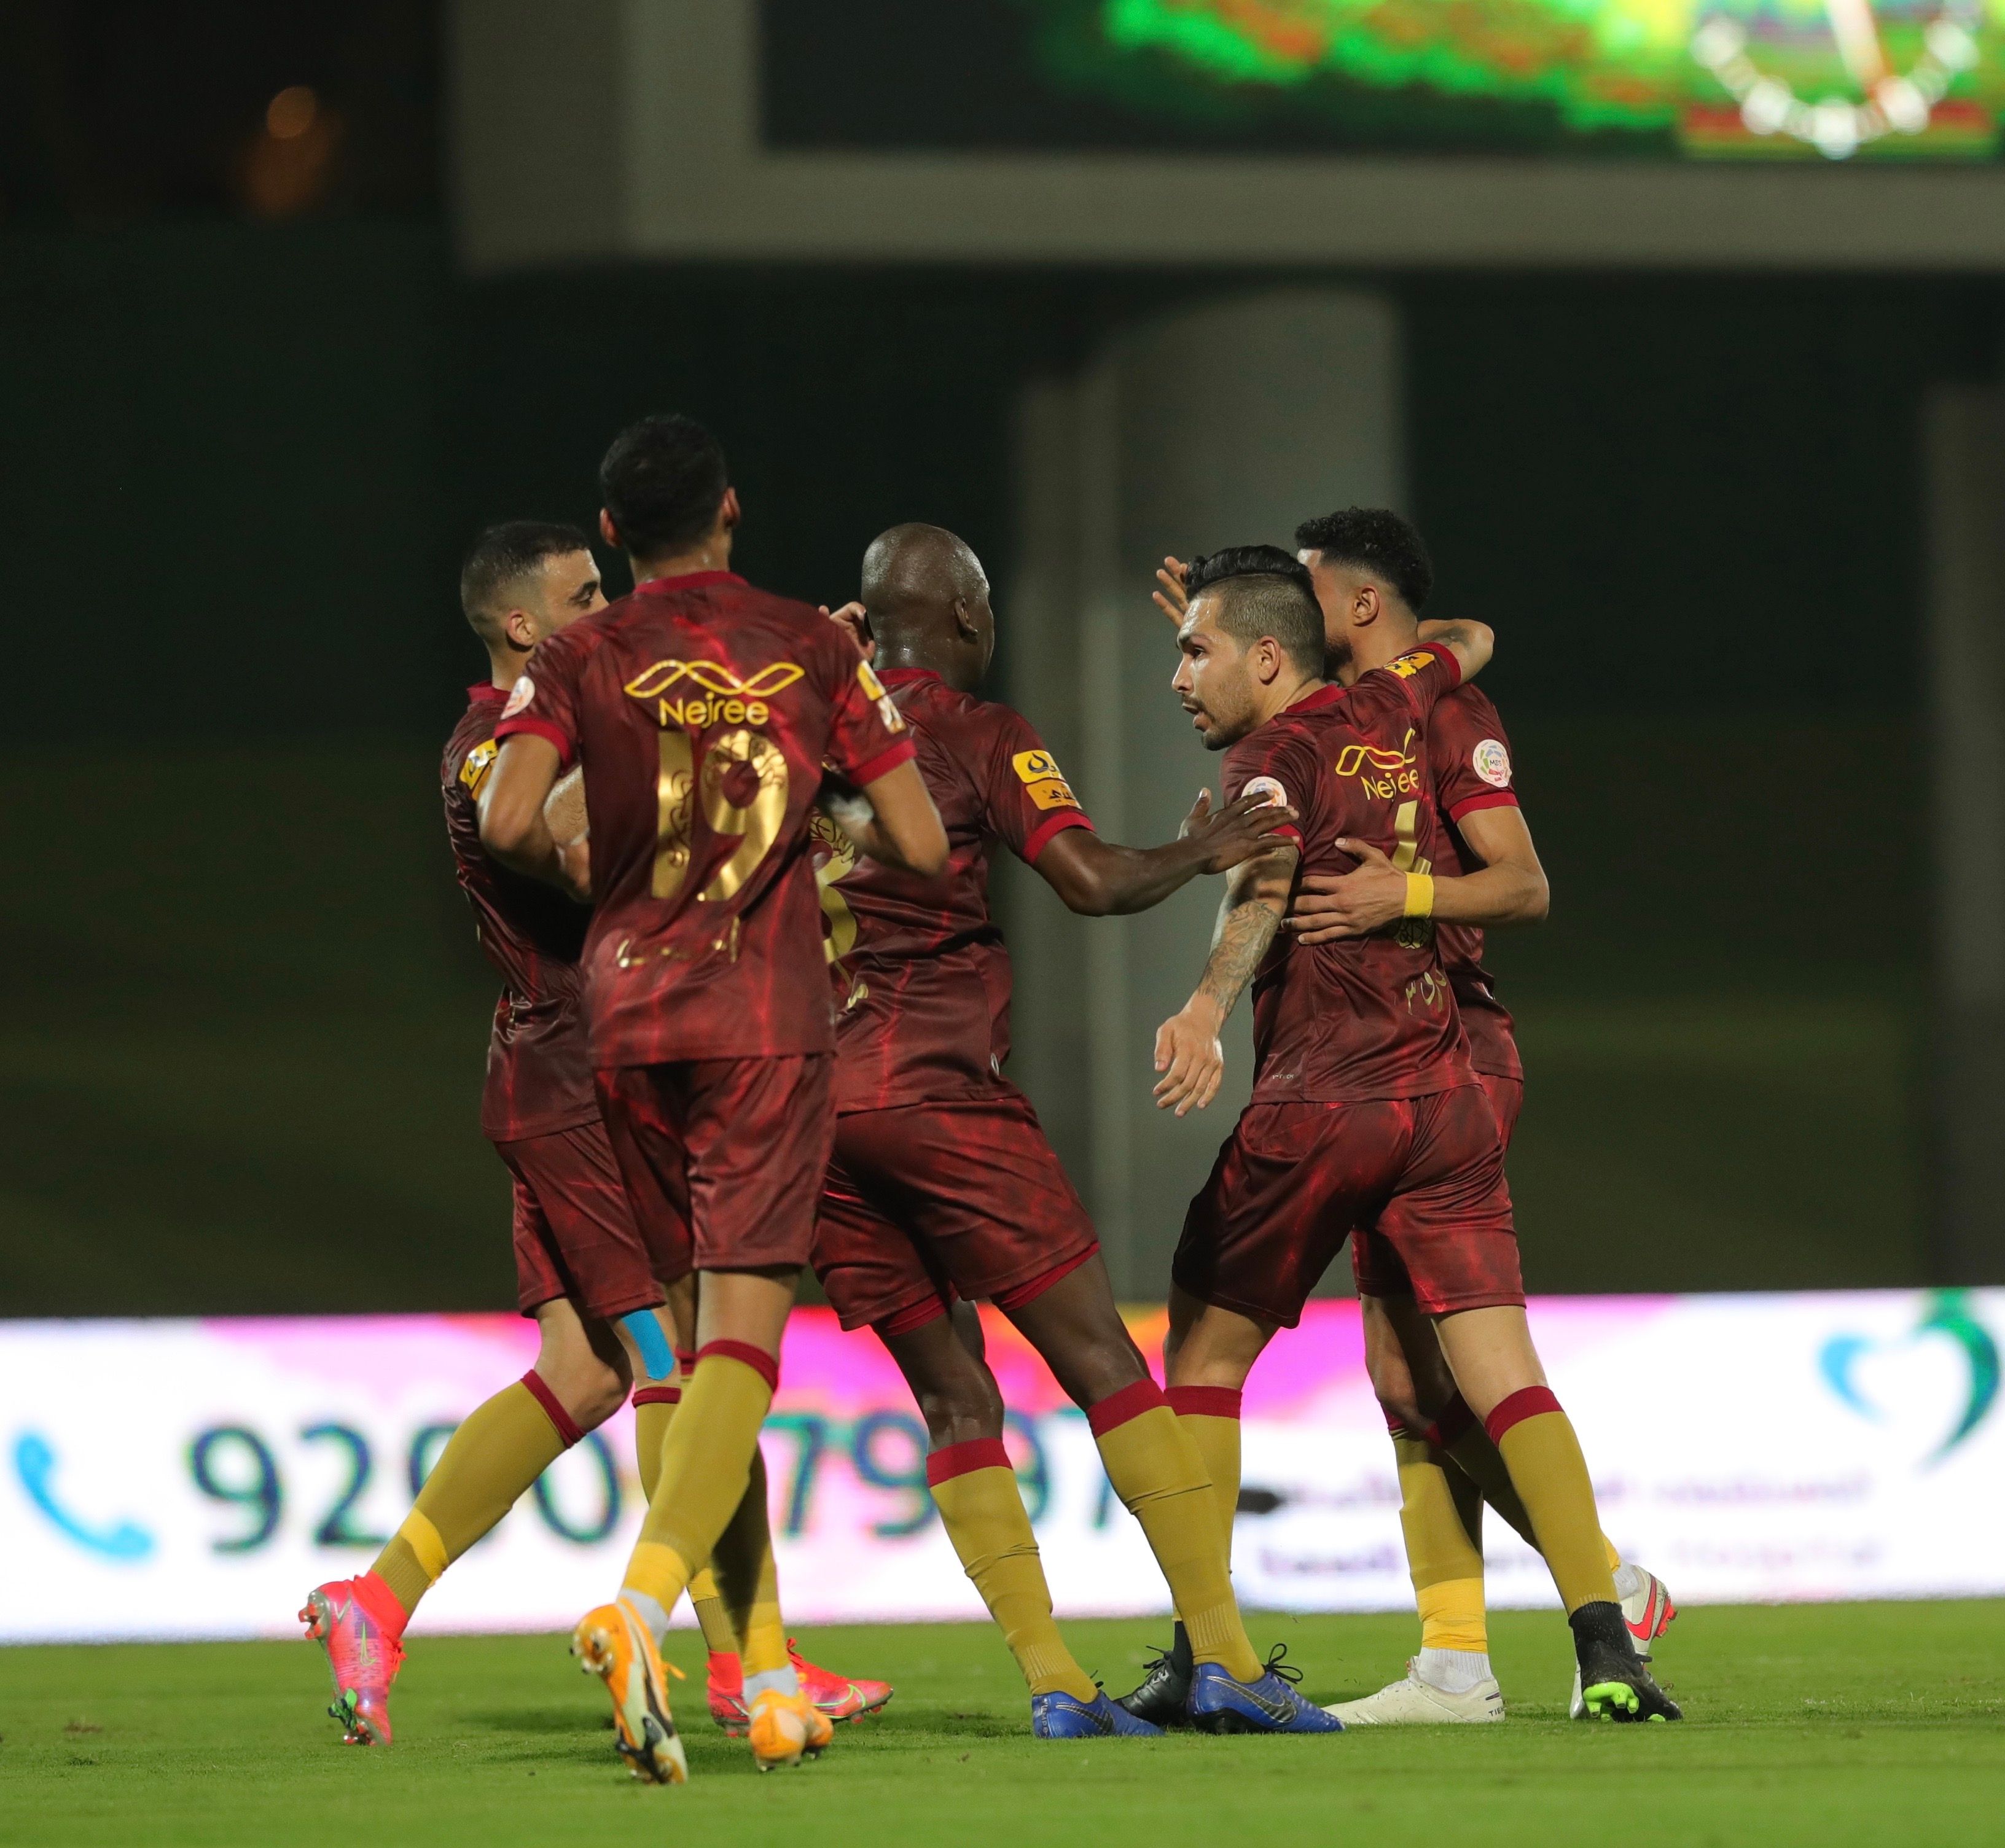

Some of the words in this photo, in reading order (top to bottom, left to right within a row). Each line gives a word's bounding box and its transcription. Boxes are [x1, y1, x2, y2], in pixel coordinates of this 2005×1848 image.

[659, 692, 769, 728] Nejree
[1361, 769, 1419, 803] Nejee
[652, 730, 789, 902] 19
